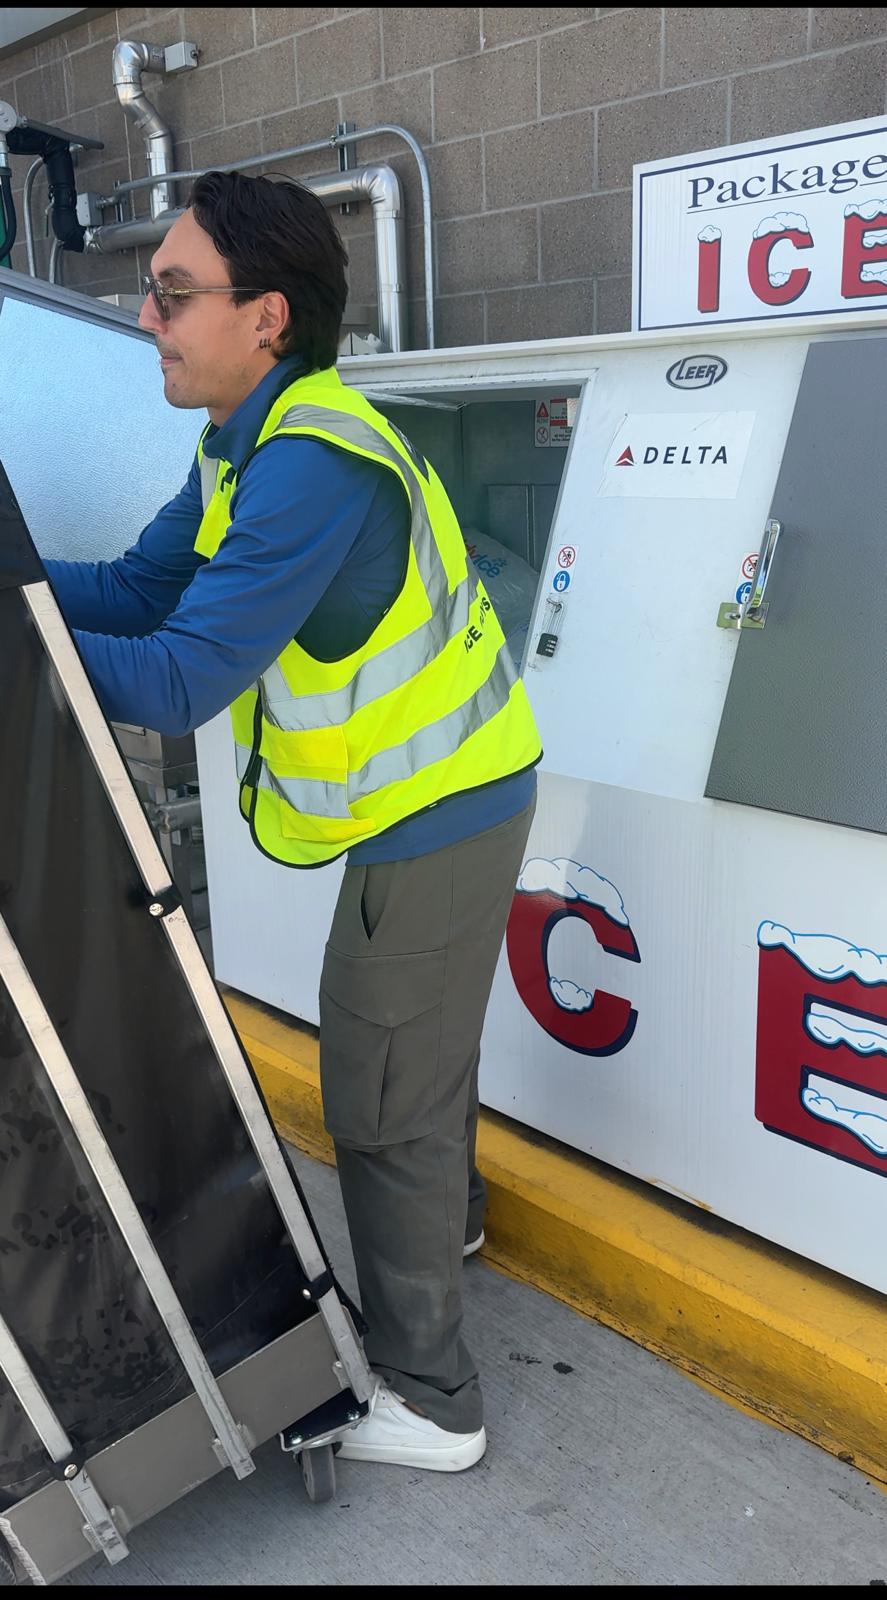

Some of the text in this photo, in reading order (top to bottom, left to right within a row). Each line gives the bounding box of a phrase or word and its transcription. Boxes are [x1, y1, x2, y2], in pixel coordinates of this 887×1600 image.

[688, 154, 887, 209] Package
[697, 199, 887, 313] ICE
[675, 360, 718, 384] LEER
[643, 446, 728, 465] DELTA
[506, 858, 887, 1177] CE
